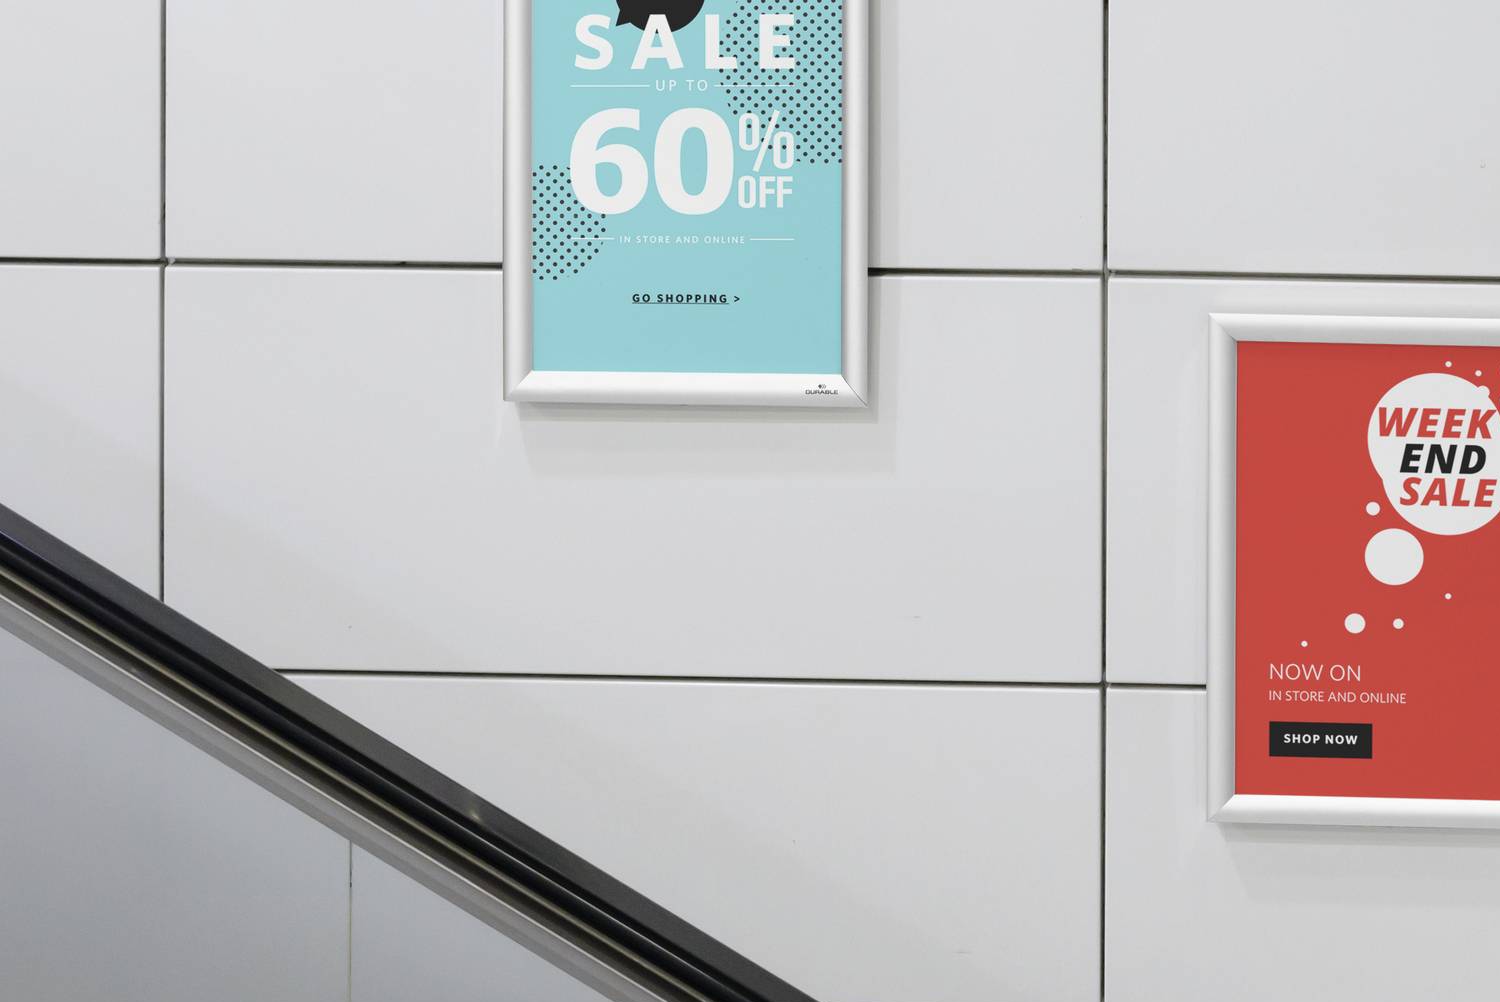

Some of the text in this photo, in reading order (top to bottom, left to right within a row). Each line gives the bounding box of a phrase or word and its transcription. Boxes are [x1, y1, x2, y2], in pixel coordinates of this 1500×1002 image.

[574, 14, 795, 71] SALE
[655, 79, 708, 92] UP TO
[738, 176, 793, 208] OFF
[619, 235, 745, 245] IN STORE AND ONLINE
[631, 293, 652, 305] GO
[655, 293, 730, 305] SHOPPING
[804, 388, 840, 396] DURABLE
[1379, 407, 1496, 439] WEEK
[1400, 444, 1486, 474] END
[1400, 477, 1497, 507] SALE
[1270, 664, 1360, 681] NOW ON
[1268, 689, 1406, 704] IN STORE AND ONLINE
[1283, 733, 1358, 745] SHOP NOW
